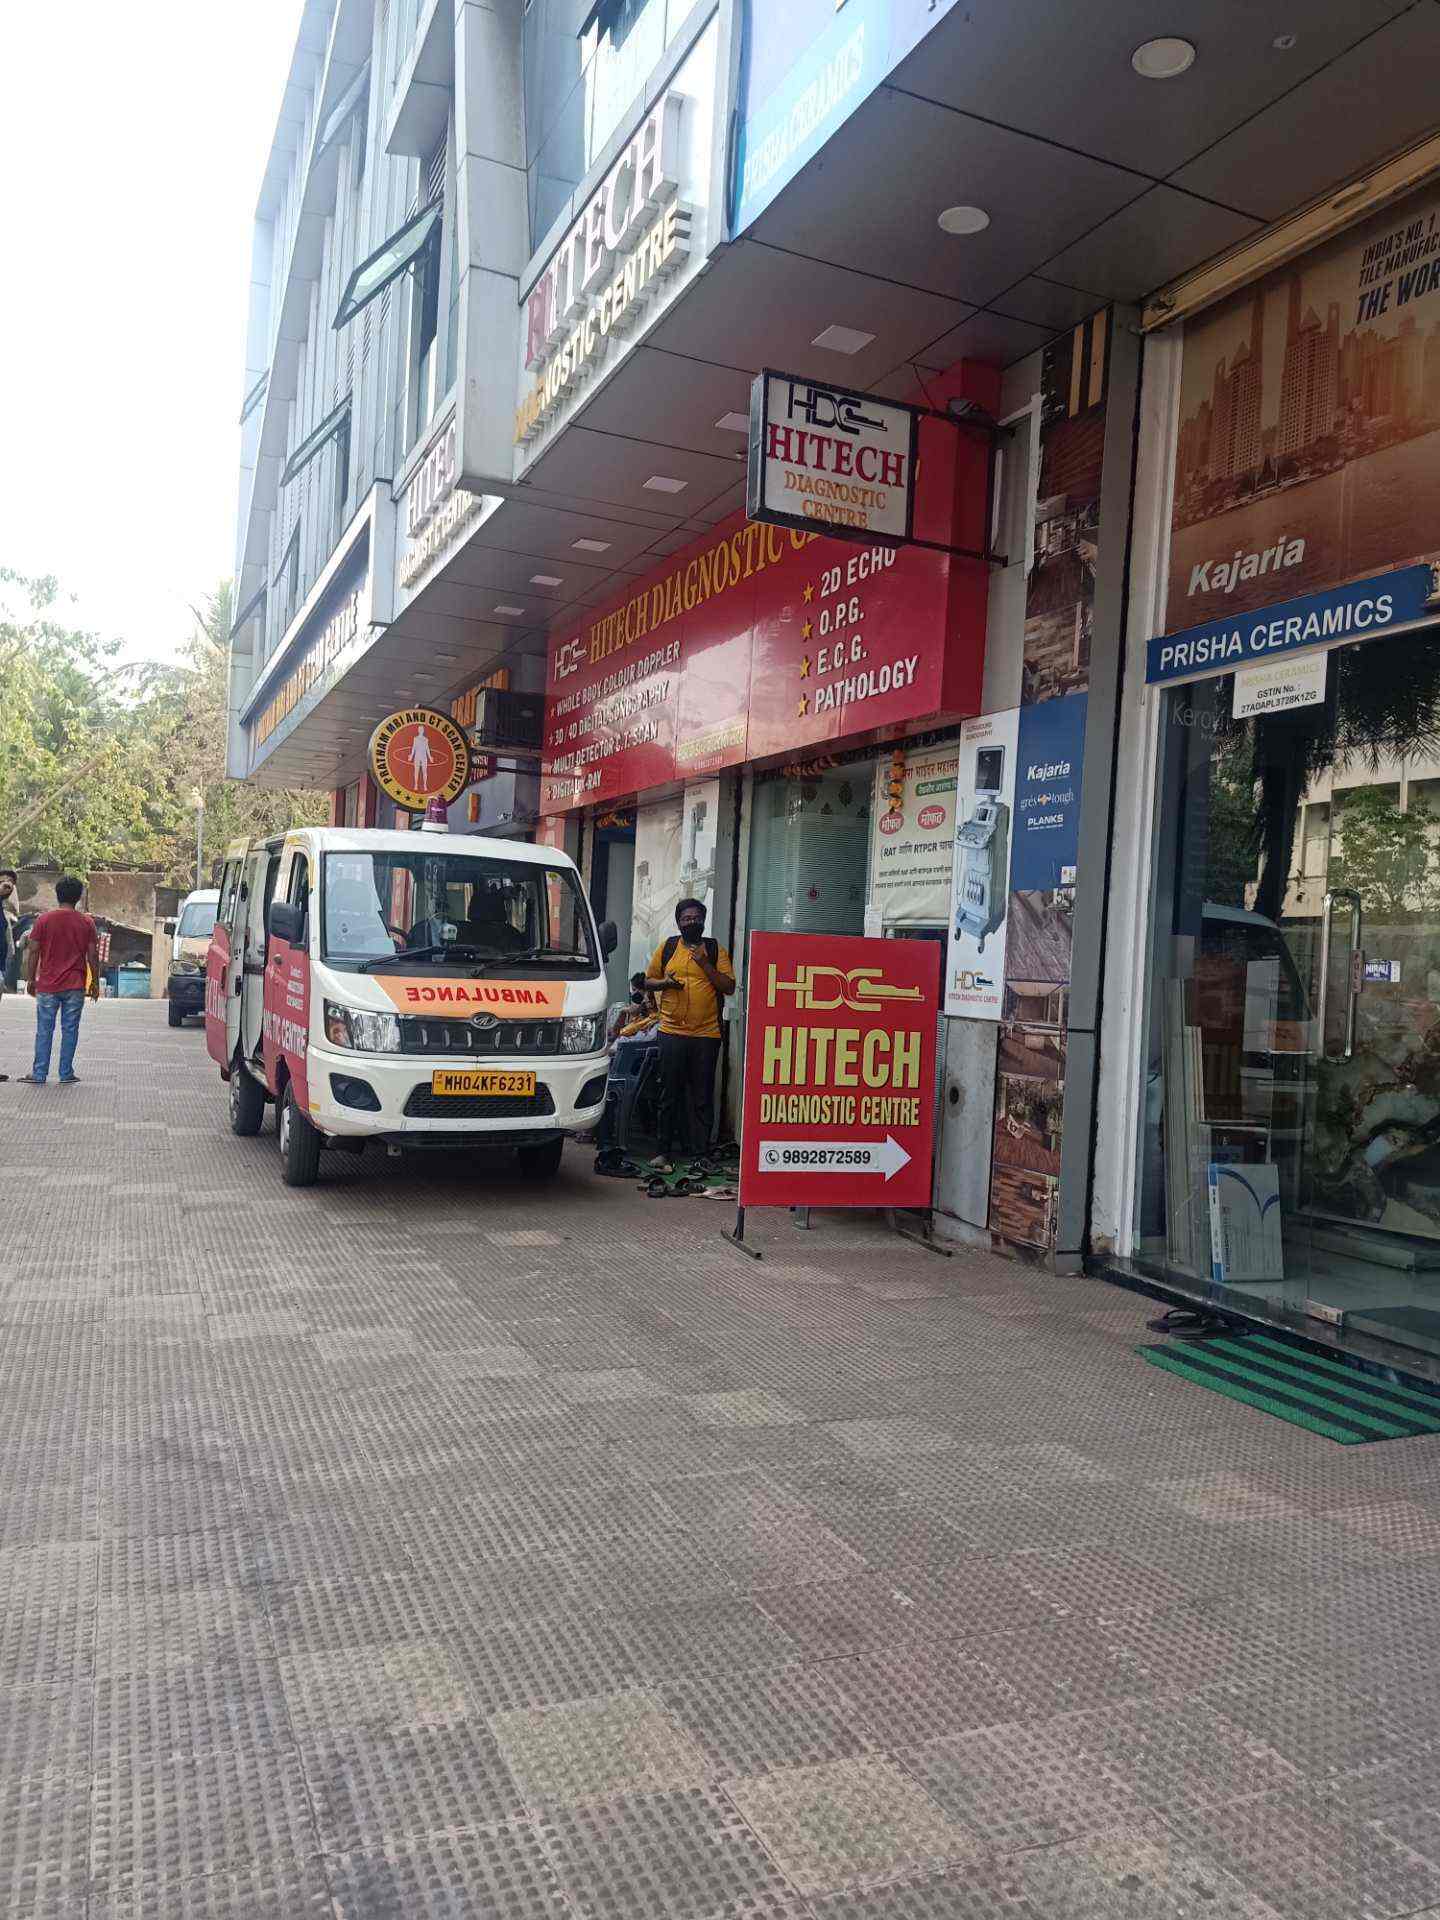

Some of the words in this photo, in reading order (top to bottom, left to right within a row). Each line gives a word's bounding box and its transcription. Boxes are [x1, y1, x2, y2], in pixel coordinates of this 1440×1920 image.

[600, 199, 680, 336] CENTRE
[1361, 230, 1404, 268] INDIA'S
[1359, 260, 1384, 288] TILE
[1356, 281, 1393, 325] THE
[767, 422, 906, 488] HITECH
[784, 470, 886, 510] DIAGNOSTIC
[802, 500, 868, 529] CENTRE
[820, 566, 842, 598] 2D
[846, 547, 896, 586] ECHO
[1187, 535, 1306, 598] Kajaria
[589, 593, 651, 664] HITECH
[650, 523, 784, 631] DIAGNOSTIC
[819, 597, 865, 636] O.P.G.
[1160, 631, 1243, 671] PRISHA
[1250, 594, 1393, 653] CERAMICS
[816, 634, 867, 676] E.C.G.
[557, 691, 581, 717] WHOLE
[604, 664, 635, 693] COLOUR
[637, 640, 681, 677] DOPPLER
[814, 656, 919, 714] PATHOLOGY
[1257, 686, 1282, 699] GSTIN
[405, 712, 426, 724] AND
[608, 680, 670, 722] SONOGRAPHY
[428, 715, 442, 729] CT
[441, 724, 463, 752] SCAN
[633, 720, 658, 746] SCAN
[376, 731, 393, 785] PRATHAM
[447, 753, 465, 792] CENTER
[1027, 761, 1071, 781] Kajaria
[1027, 814, 1064, 826] PLANKS
[913, 842, 938, 854] RTPCR
[767, 963, 884, 1012] HDC
[761, 1025, 921, 1089] HITECH
[444, 1074, 532, 1092] MH04KF6231
[760, 1094, 856, 1125] DIAGNOSTIC
[860, 1095, 921, 1126] CENTRE
[782, 1149, 872, 1165] 9892872589
